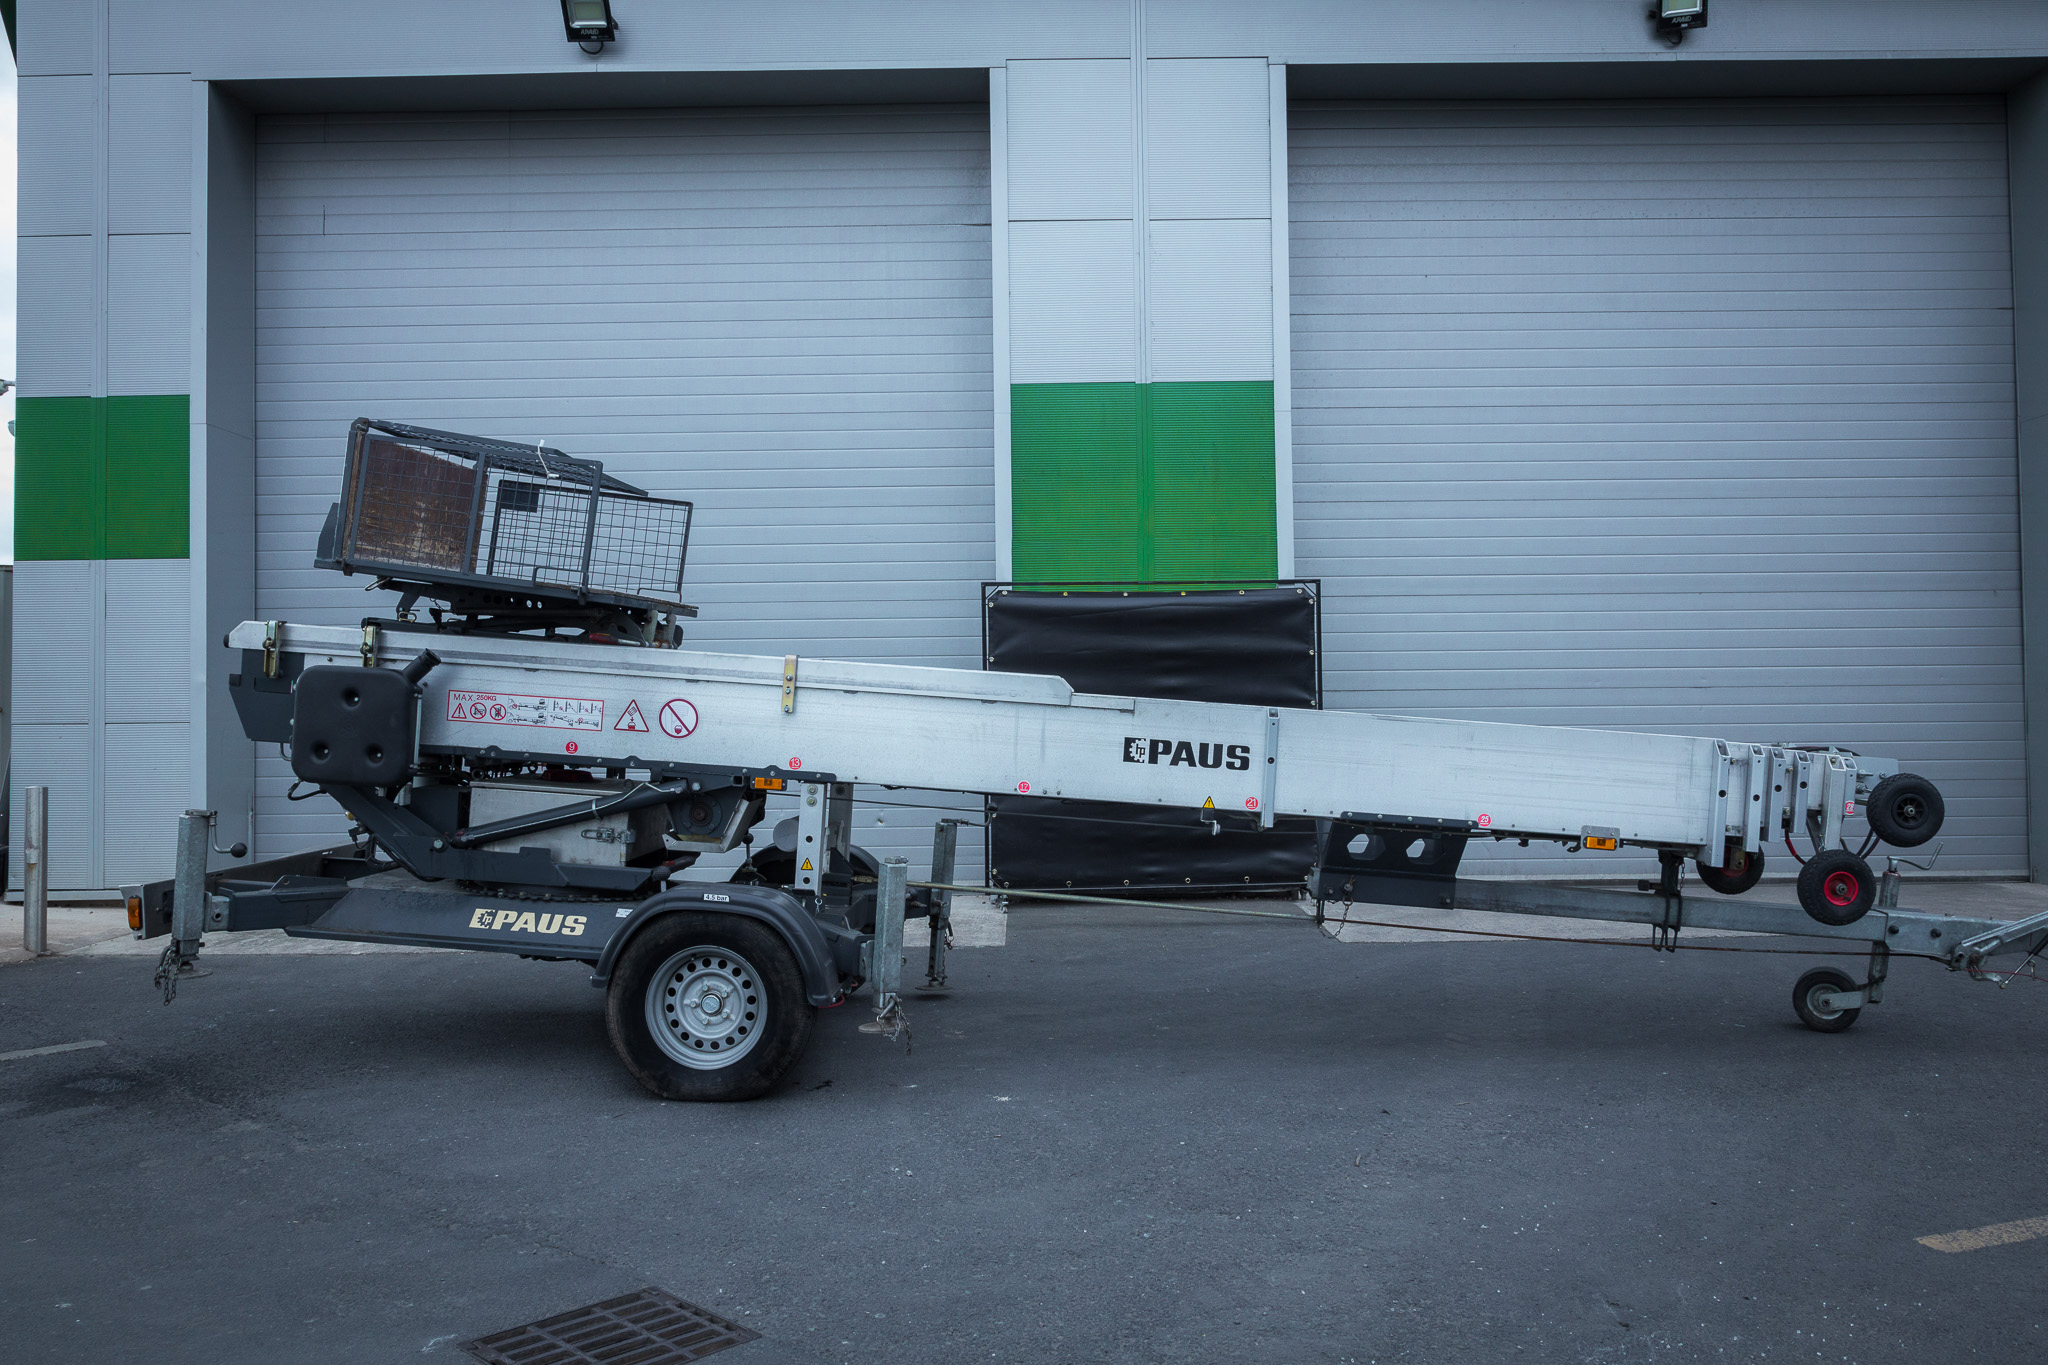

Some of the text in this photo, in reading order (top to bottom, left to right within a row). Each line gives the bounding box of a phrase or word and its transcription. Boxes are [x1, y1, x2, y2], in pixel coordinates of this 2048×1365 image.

[453, 693, 497, 702] MAX. 250KG
[1148, 738, 1251, 771] PAUS
[491, 910, 588, 936] PAUS
